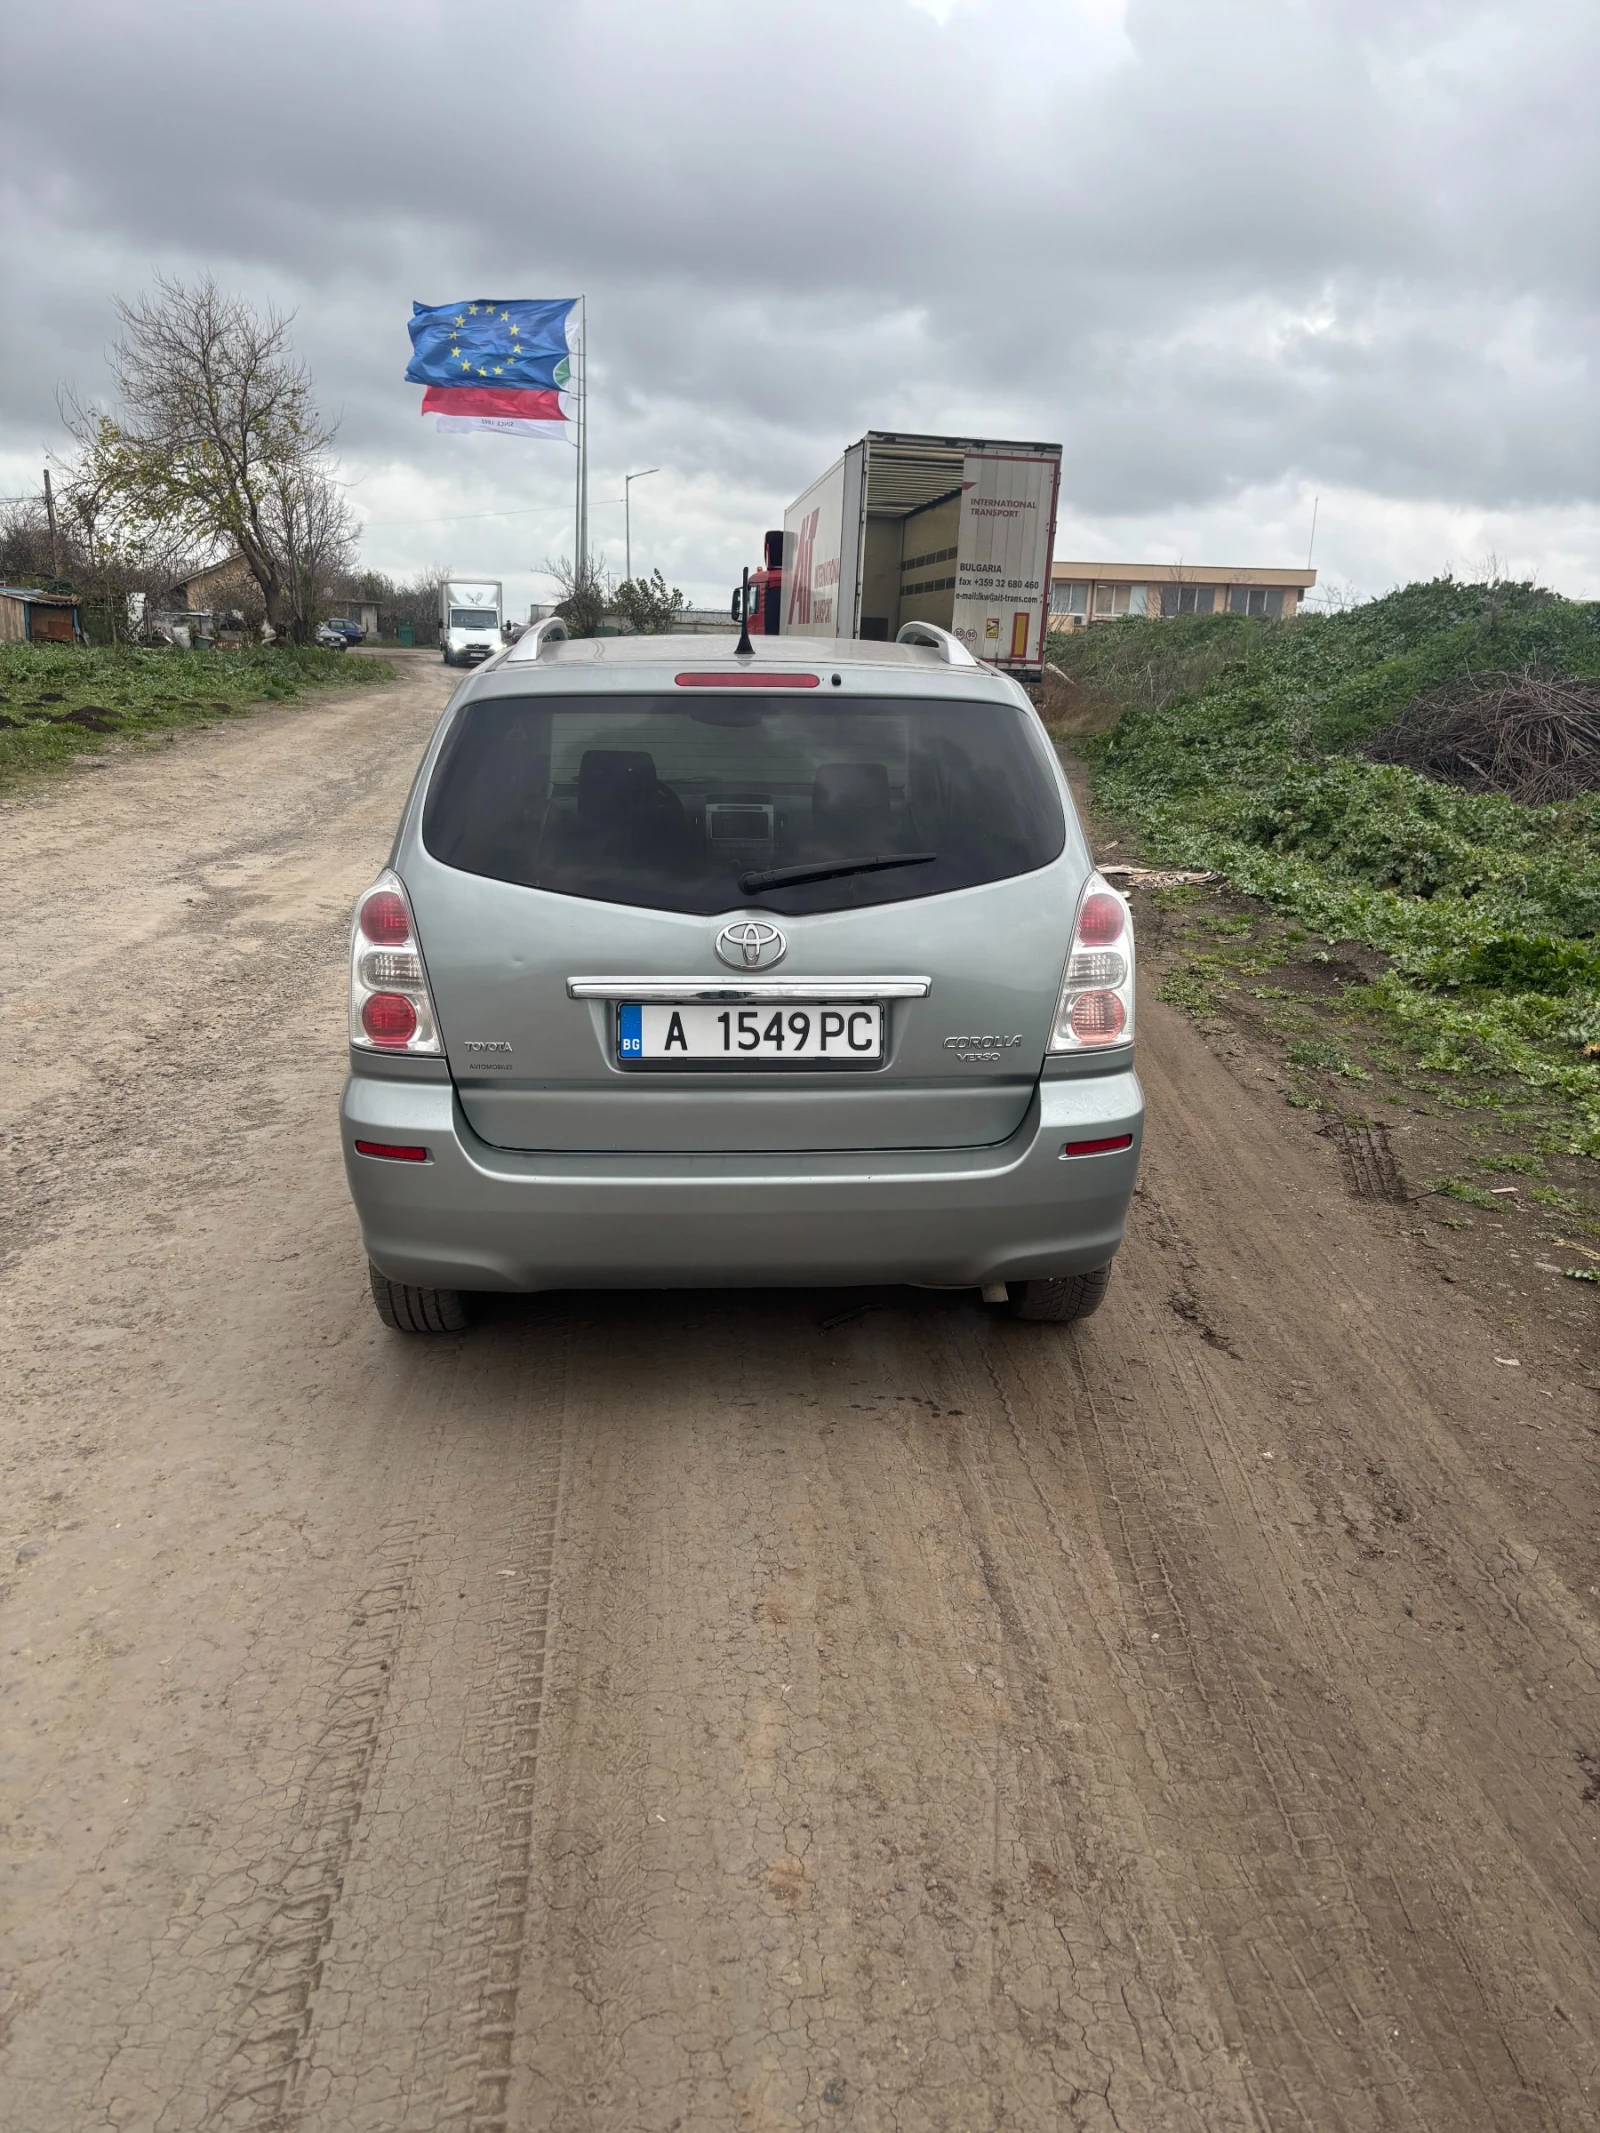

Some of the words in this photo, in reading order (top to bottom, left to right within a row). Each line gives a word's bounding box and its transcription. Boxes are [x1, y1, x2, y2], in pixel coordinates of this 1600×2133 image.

[970, 498, 1037, 509] INTERNATIONAL
[970, 508, 1019, 518] TRANSPORT
[959, 563, 1002, 573] BULGARIA
[959, 577, 972, 586] fax
[974, 578, 993, 587] +359
[995, 579, 1006, 588] 32
[1007, 580, 1022, 589] 680
[1024, 581, 1039, 589] 460
[622, 1038, 640, 1051] BG
[664, 1011, 688, 1051] A
[464, 1041, 513, 1052] TOYOTA
[942, 1034, 1022, 1049] COROLLA
[956, 1052, 1000, 1062] VERSO
